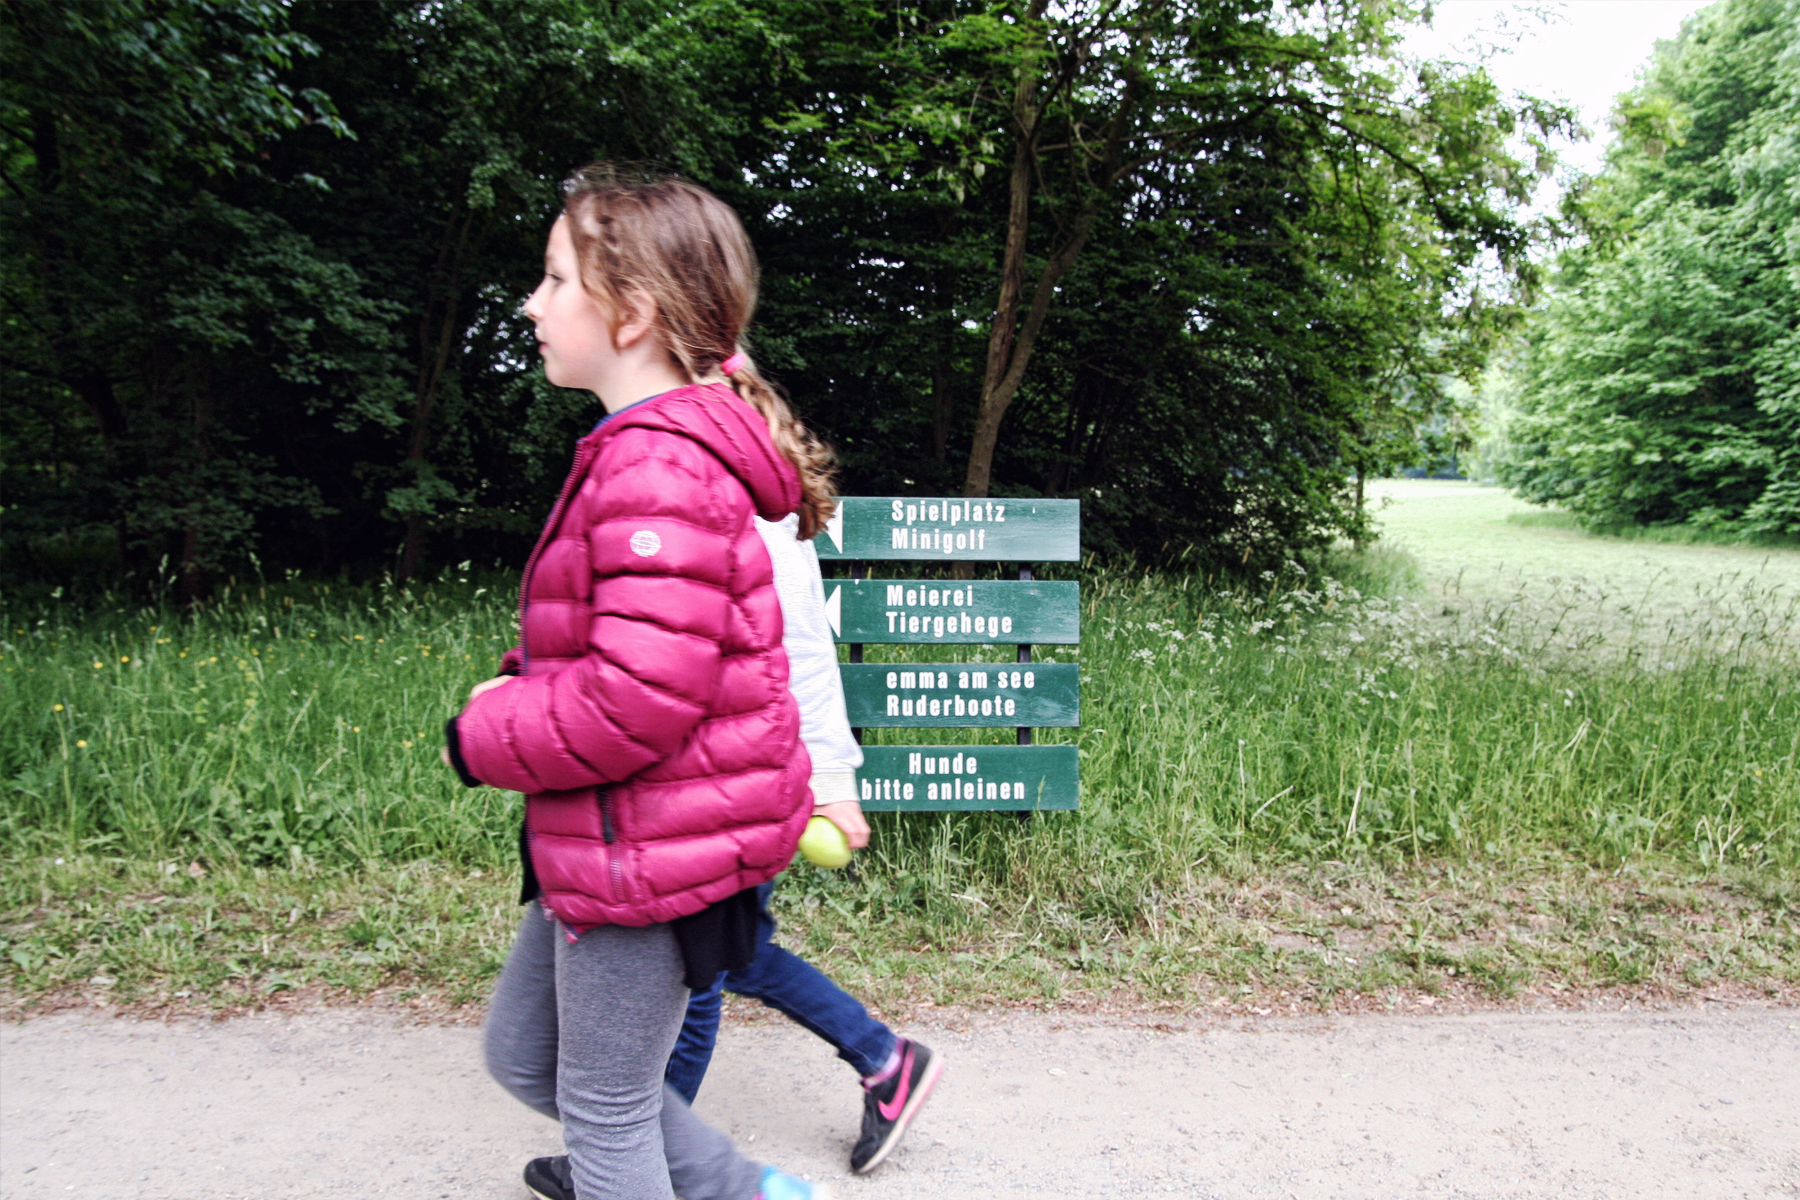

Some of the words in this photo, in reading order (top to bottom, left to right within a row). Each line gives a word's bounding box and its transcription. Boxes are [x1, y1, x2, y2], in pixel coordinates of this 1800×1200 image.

[891, 499, 1005, 526] Spielplatz
[891, 528, 985, 554] Minigolf
[886, 584, 973, 607] Meierei
[885, 611, 1013, 638] Tiergehege
[886, 671, 948, 689] emma
[958, 671, 988, 689] am
[997, 671, 1035, 689] see
[886, 694, 1016, 717] Ruderboote
[908, 752, 977, 775] Hunde
[861, 778, 914, 801] bitte
[927, 777, 1025, 800] anleinen
